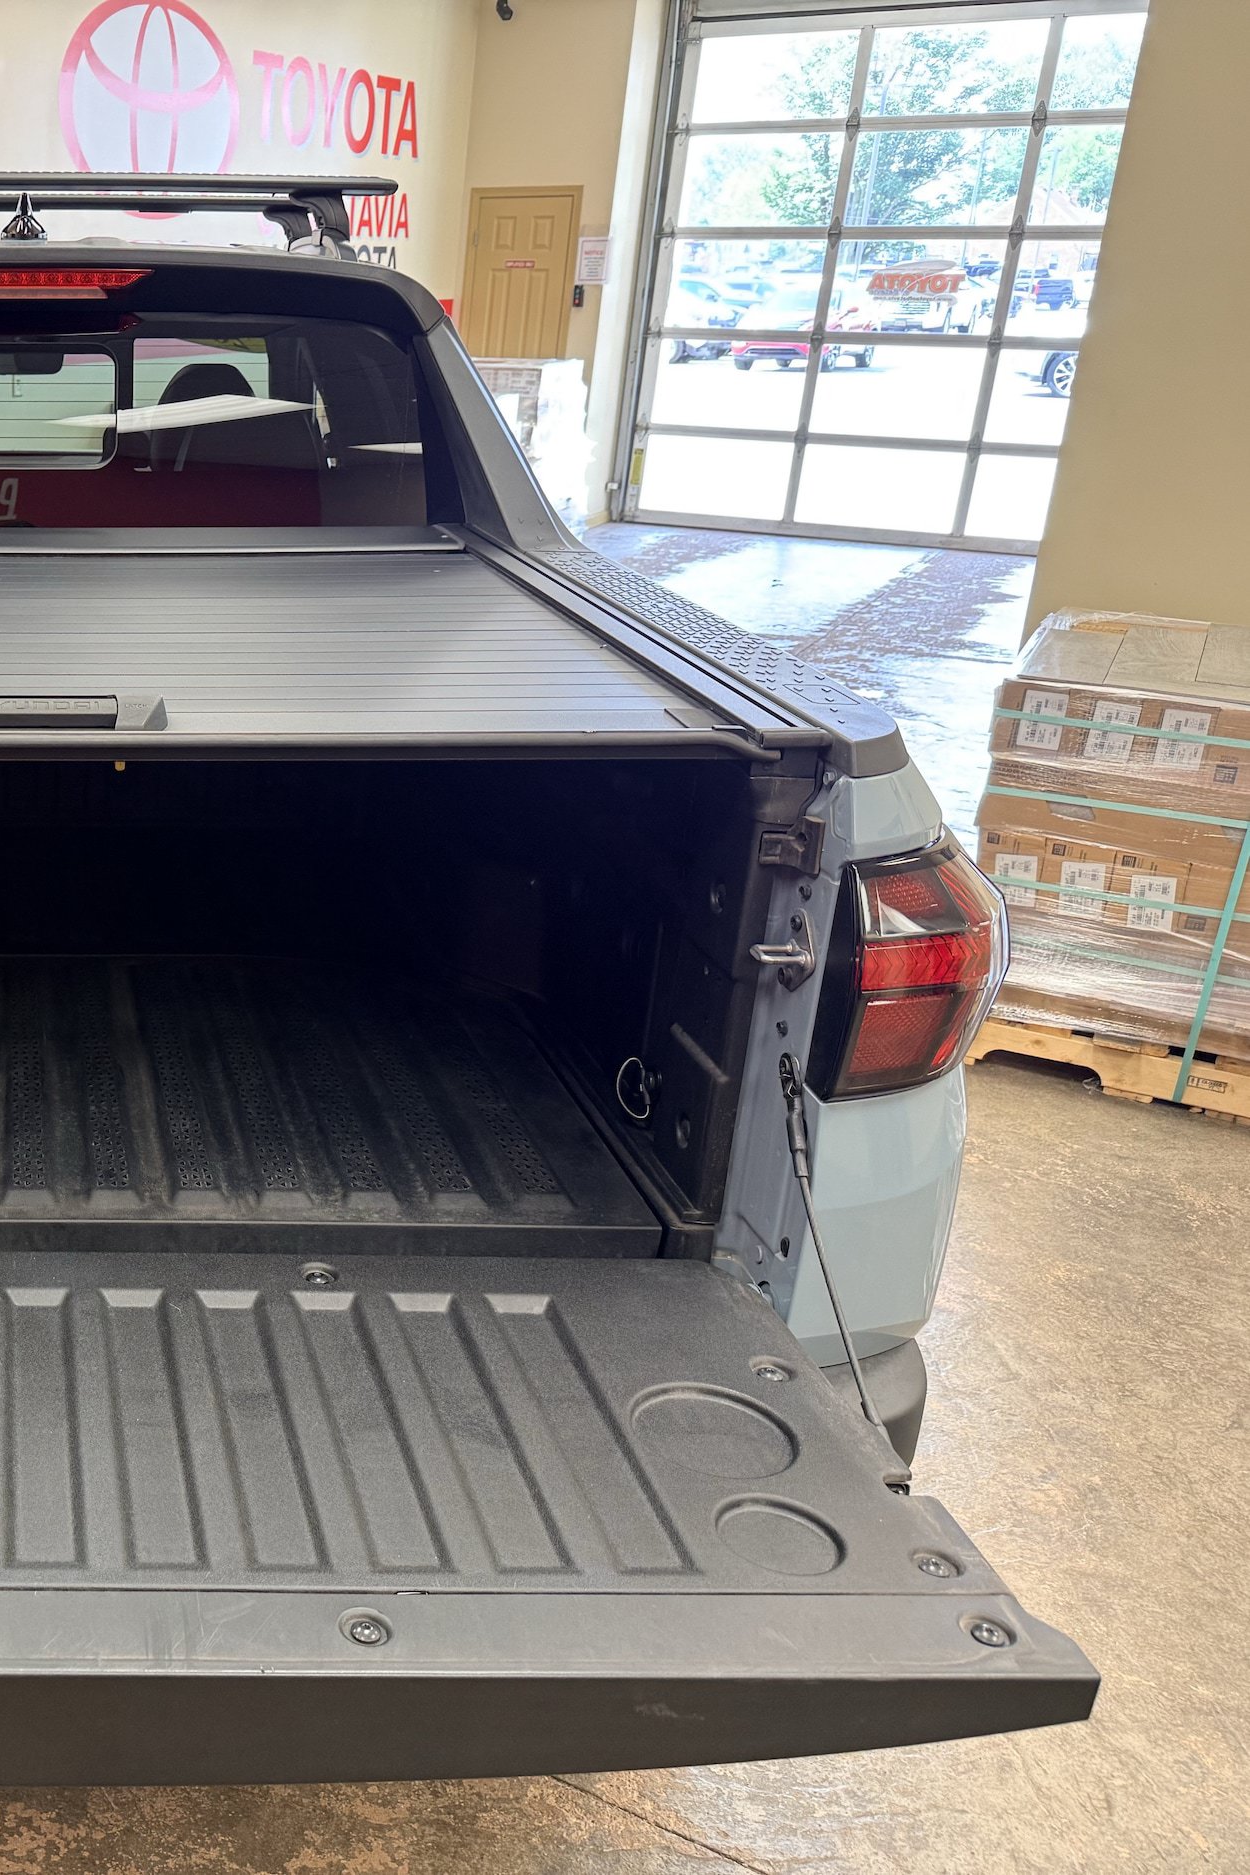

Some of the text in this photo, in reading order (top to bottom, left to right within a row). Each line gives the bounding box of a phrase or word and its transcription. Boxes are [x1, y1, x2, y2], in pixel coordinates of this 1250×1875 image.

[252, 50, 418, 159] TOYOTA
[349, 193, 409, 238] AVIA
[123, 702, 150, 710] LATCH
